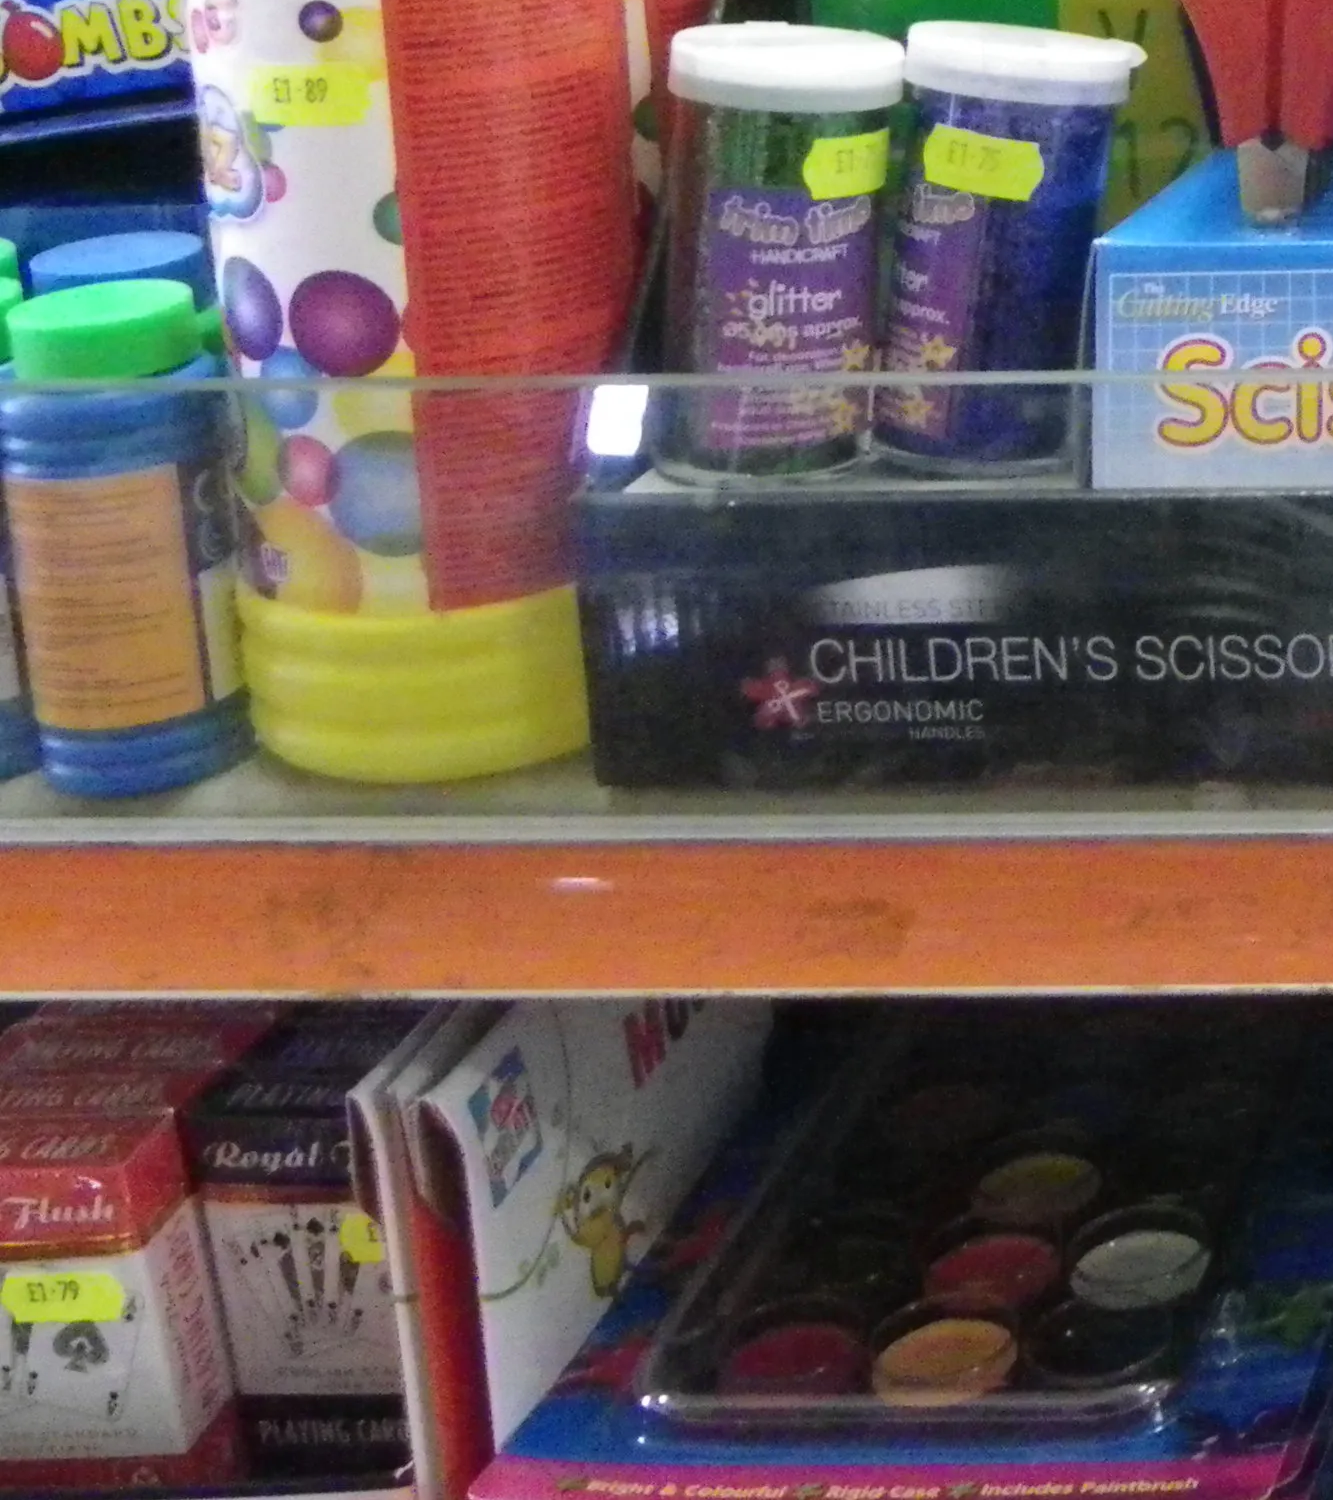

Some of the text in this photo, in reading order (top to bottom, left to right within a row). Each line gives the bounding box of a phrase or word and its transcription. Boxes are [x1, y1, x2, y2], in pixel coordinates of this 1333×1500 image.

[748, 279, 843, 321] glitter
[1219, 292, 1279, 321] Edge
[809, 635, 1117, 685] CHILDREN'S
[816, 698, 985, 725] ERGONOMIC
[204, 1139, 322, 1172] Royal
[7, 1197, 116, 1231] Flush
